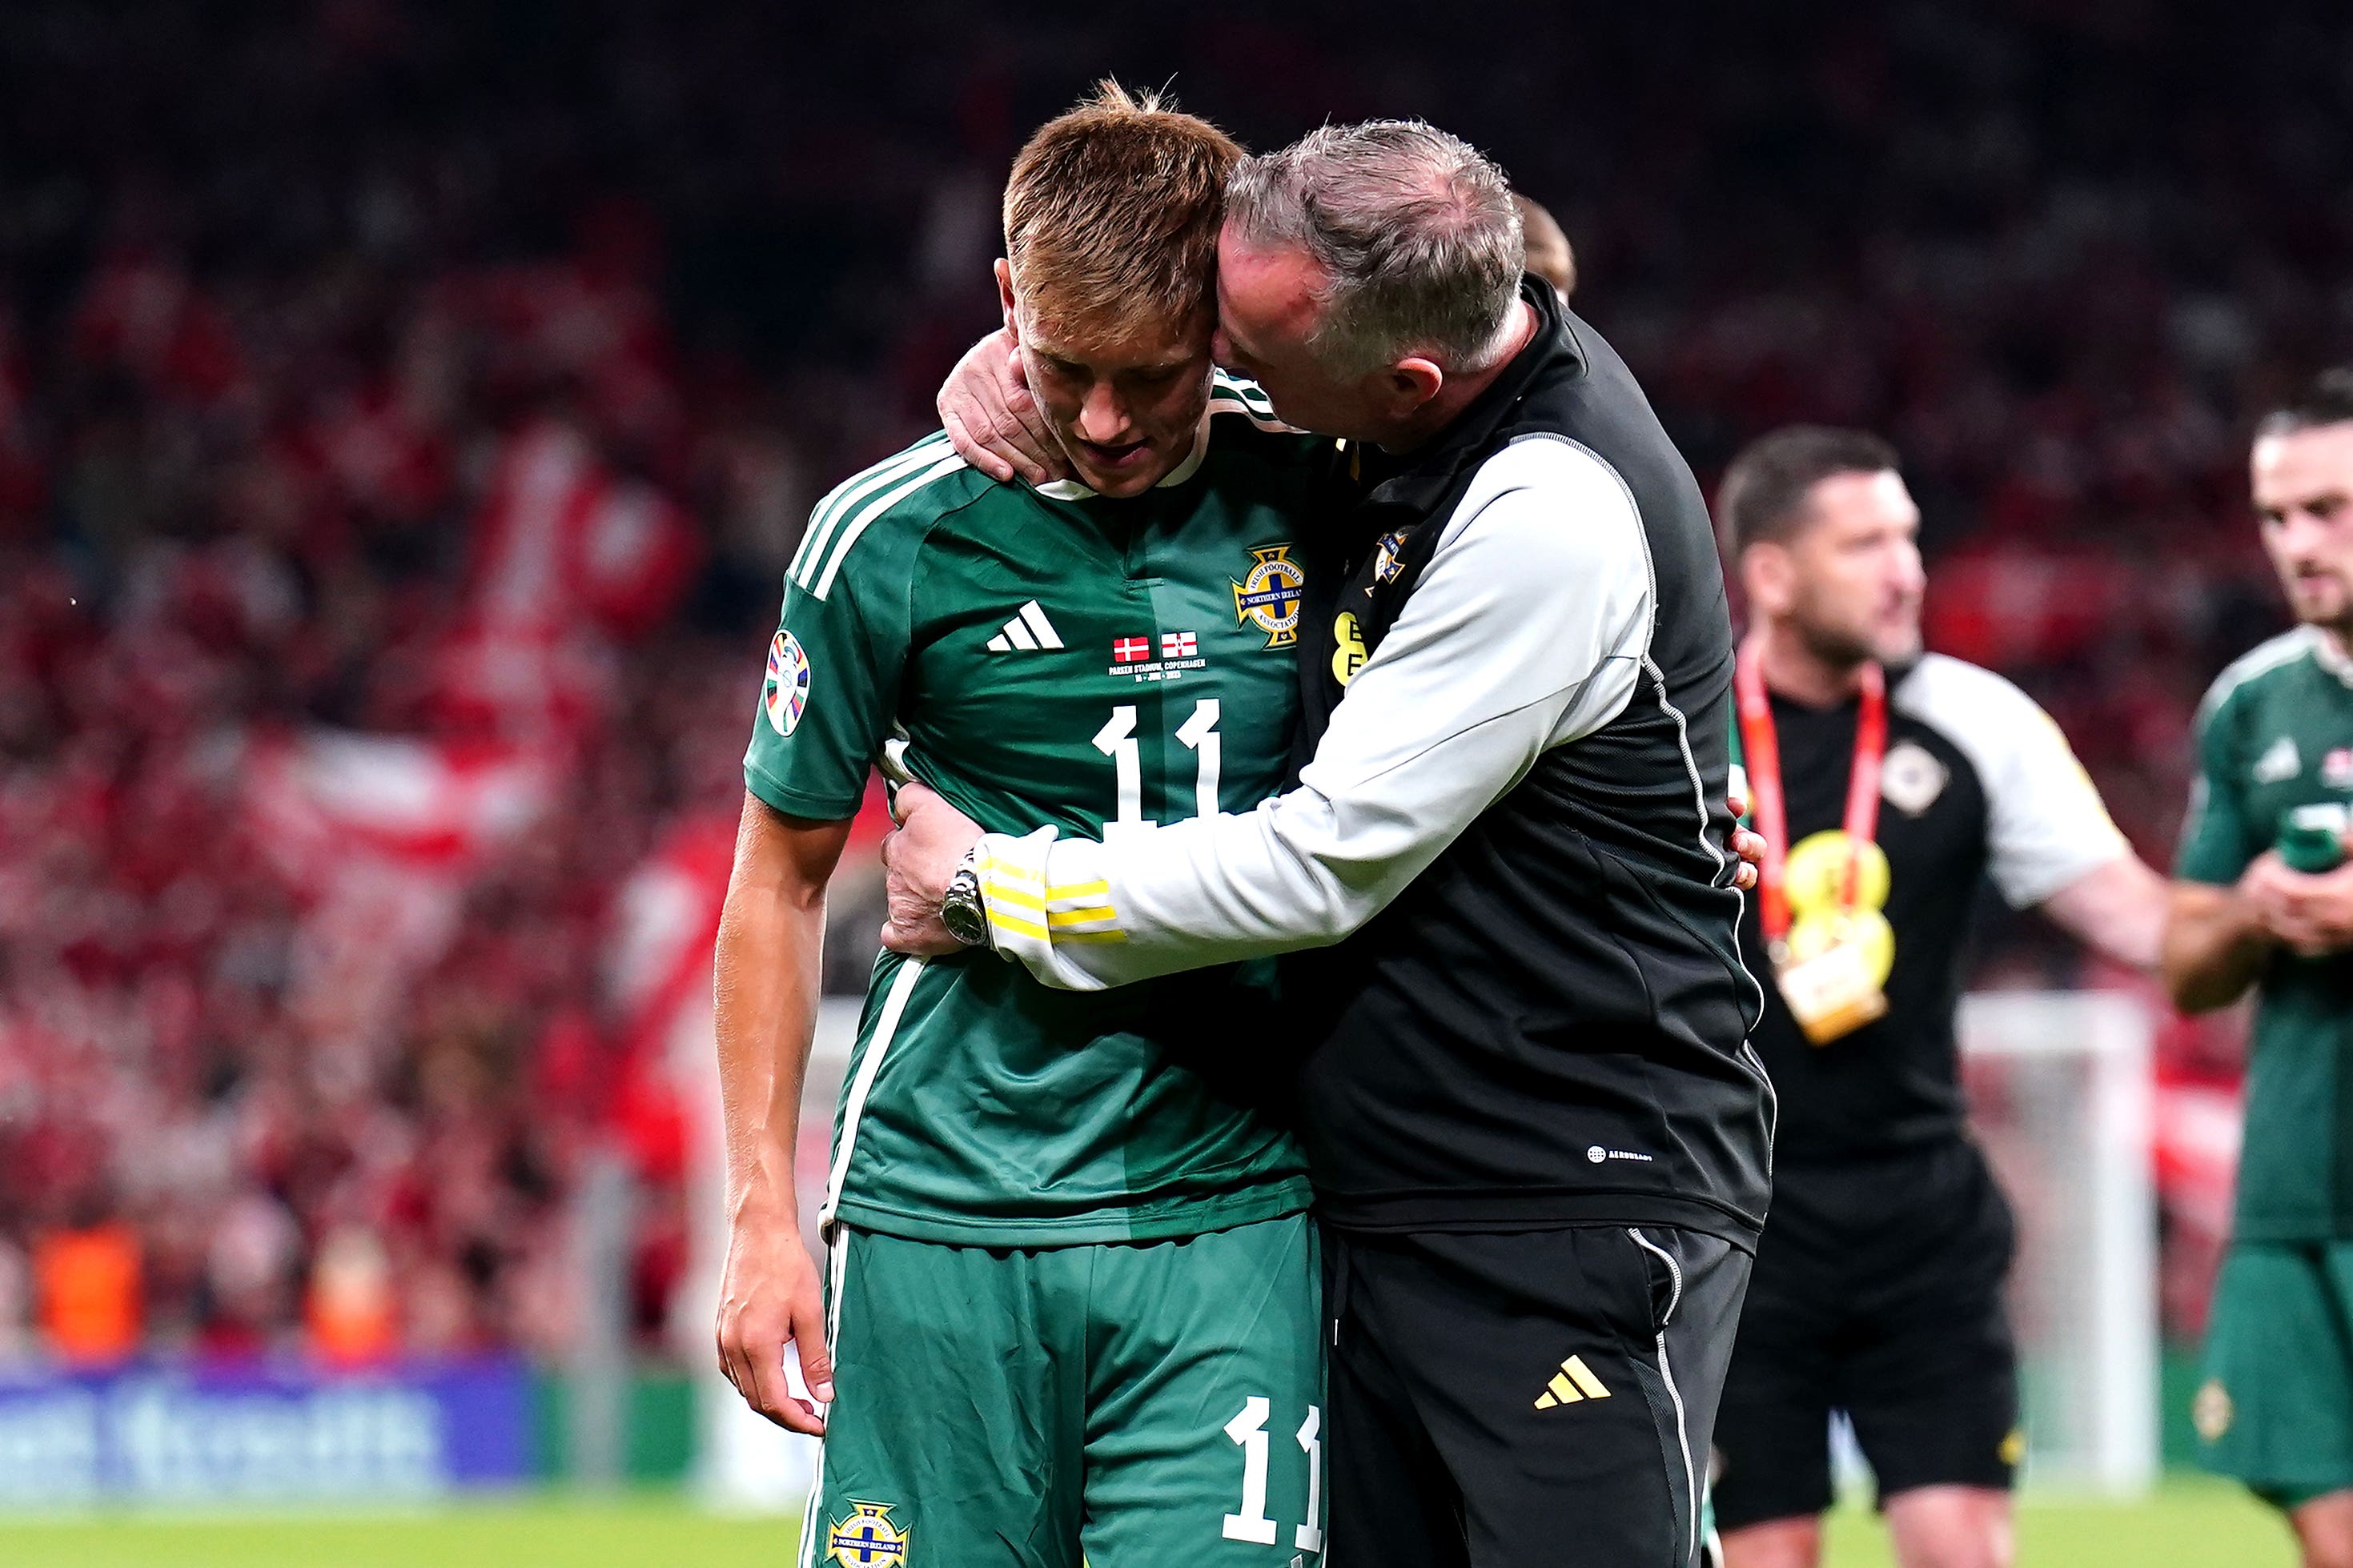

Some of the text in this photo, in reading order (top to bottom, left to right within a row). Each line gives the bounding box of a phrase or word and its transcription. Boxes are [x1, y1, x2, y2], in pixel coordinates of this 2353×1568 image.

[1250, 563, 1300, 589] IRISH FOOTBALL
[1247, 589, 1302, 604] NORTHERN IRELA
[1258, 611, 1299, 629] ASSOCIATIO
[1108, 659, 1206, 676] PARKEN STADIUM, COPENHAGEN
[1091, 697, 1223, 834] 11
[1222, 1396, 1322, 1554] 11
